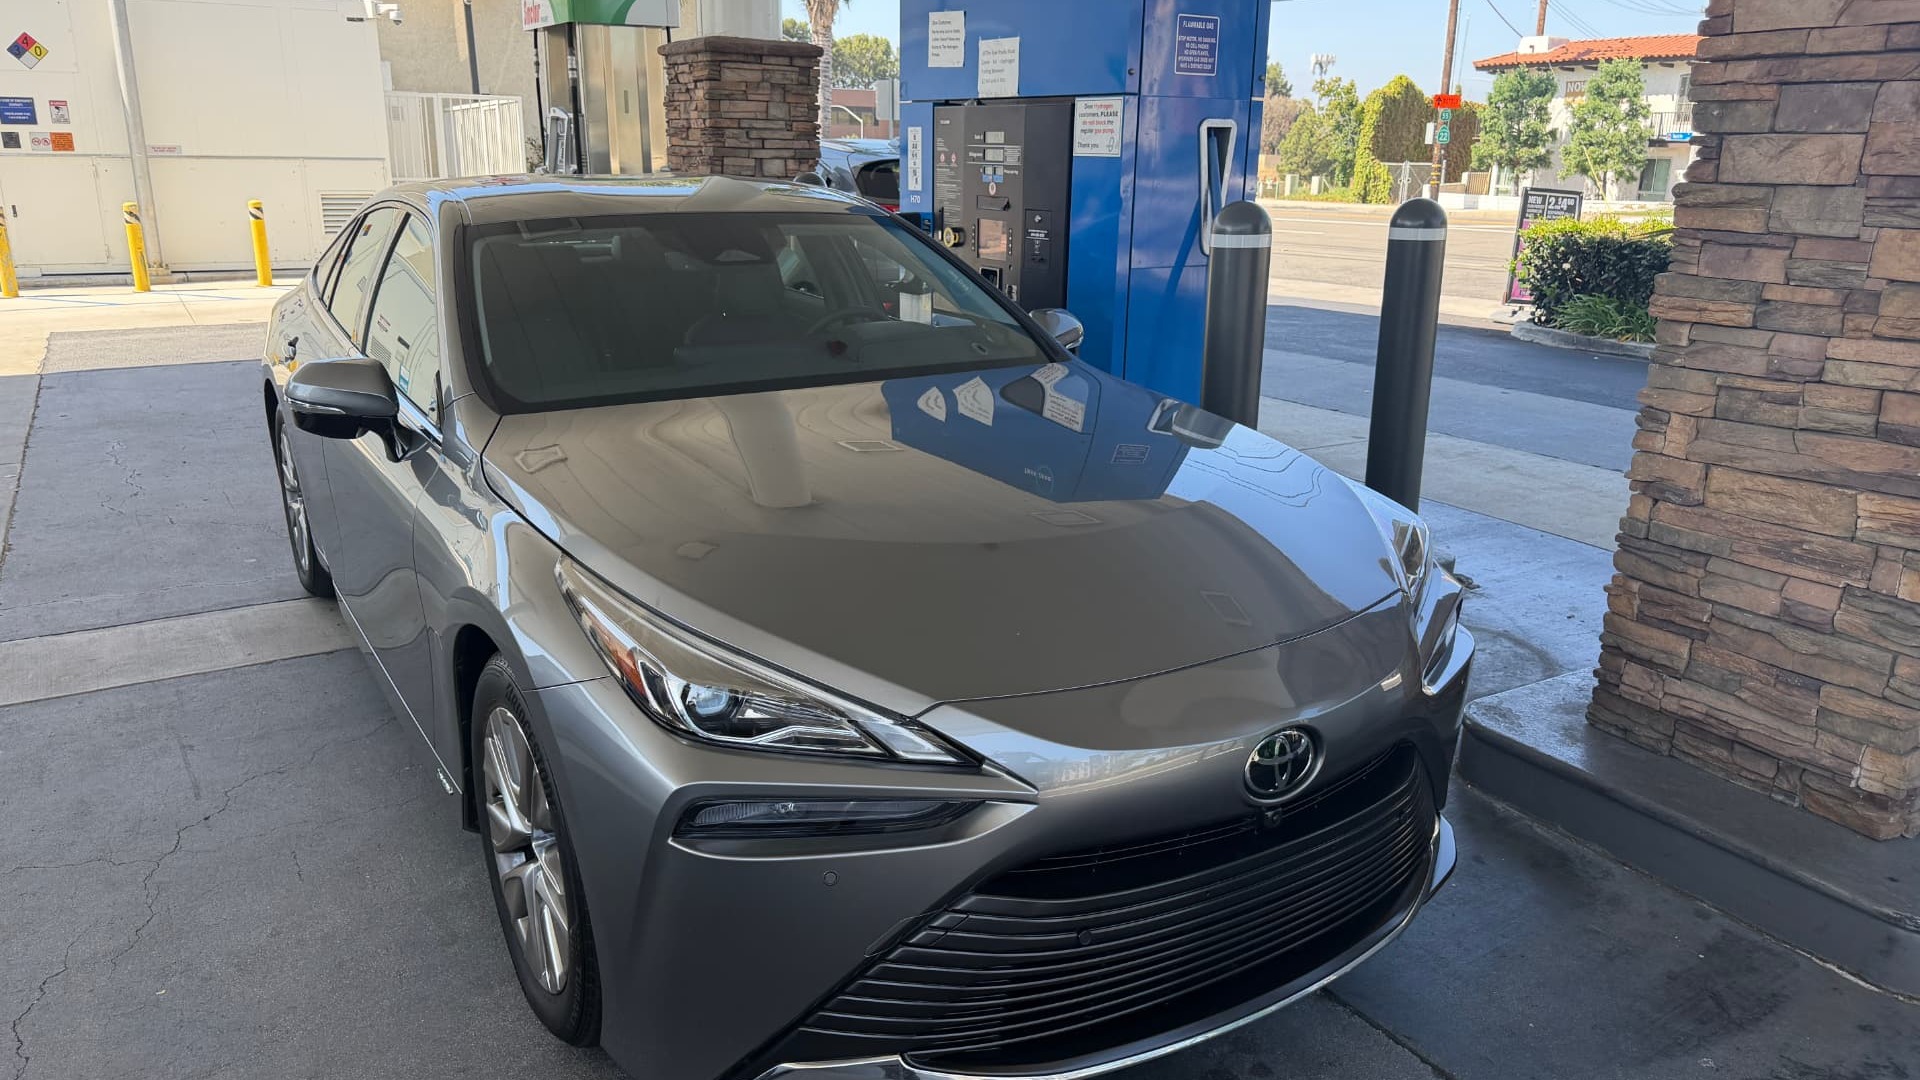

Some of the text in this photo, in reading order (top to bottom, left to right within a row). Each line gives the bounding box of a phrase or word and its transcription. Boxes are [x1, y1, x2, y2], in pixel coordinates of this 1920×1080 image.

[22, 36, 29, 47] 4
[34, 45, 42, 57] 0
[1438, 132, 1448, 141] 22
[910, 195, 921, 204] H70
[1528, 195, 1543, 205] NEW
